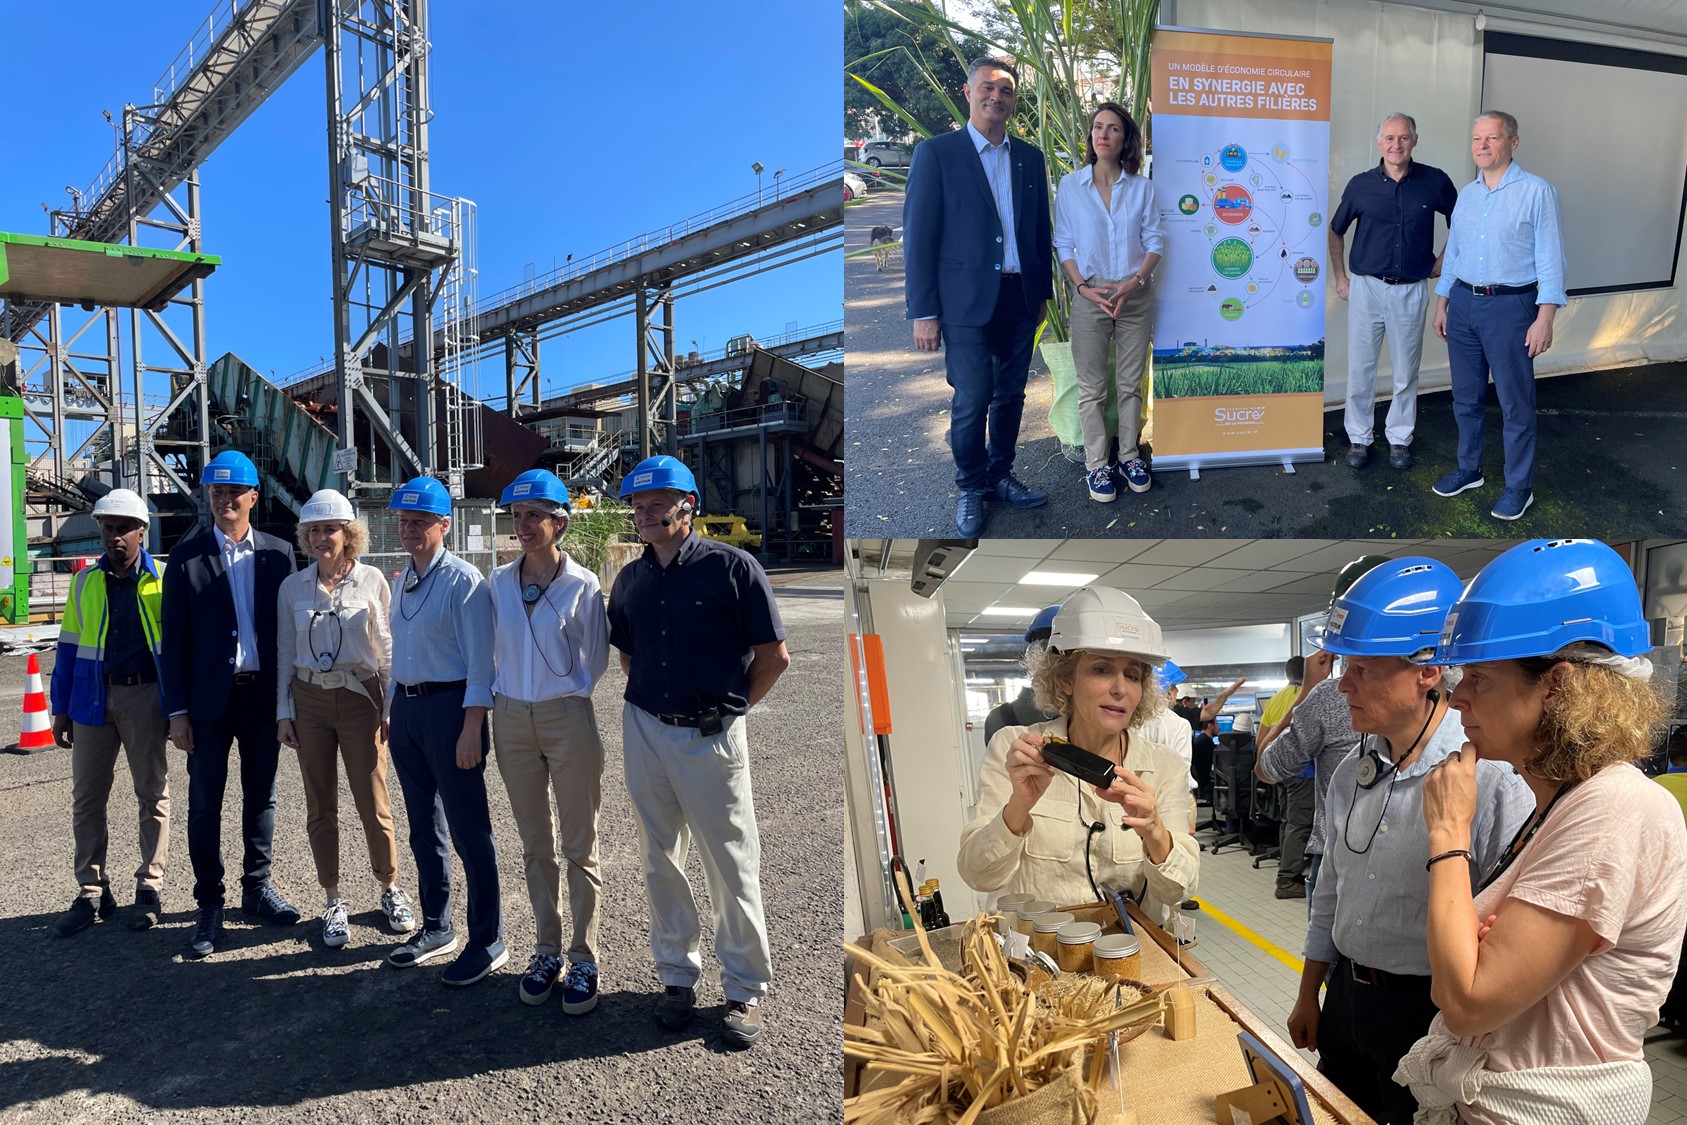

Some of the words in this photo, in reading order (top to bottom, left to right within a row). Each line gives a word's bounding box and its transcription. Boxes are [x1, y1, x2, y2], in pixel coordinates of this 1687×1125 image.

[1168, 62, 1181, 71] UN
[1182, 62, 1216, 73] MODÈLE
[1217, 64, 1266, 76] D'ÉCONOMIE
[1267, 68, 1311, 78] CIRCULAIRE
[1169, 76, 1189, 90] EN
[1193, 77, 1265, 94] SYNERGIE
[1268, 82, 1305, 96] AVEC
[1169, 91, 1196, 106] LES
[1199, 93, 1254, 109] AUTRES
[1257, 95, 1317, 111] FILIÈRES
